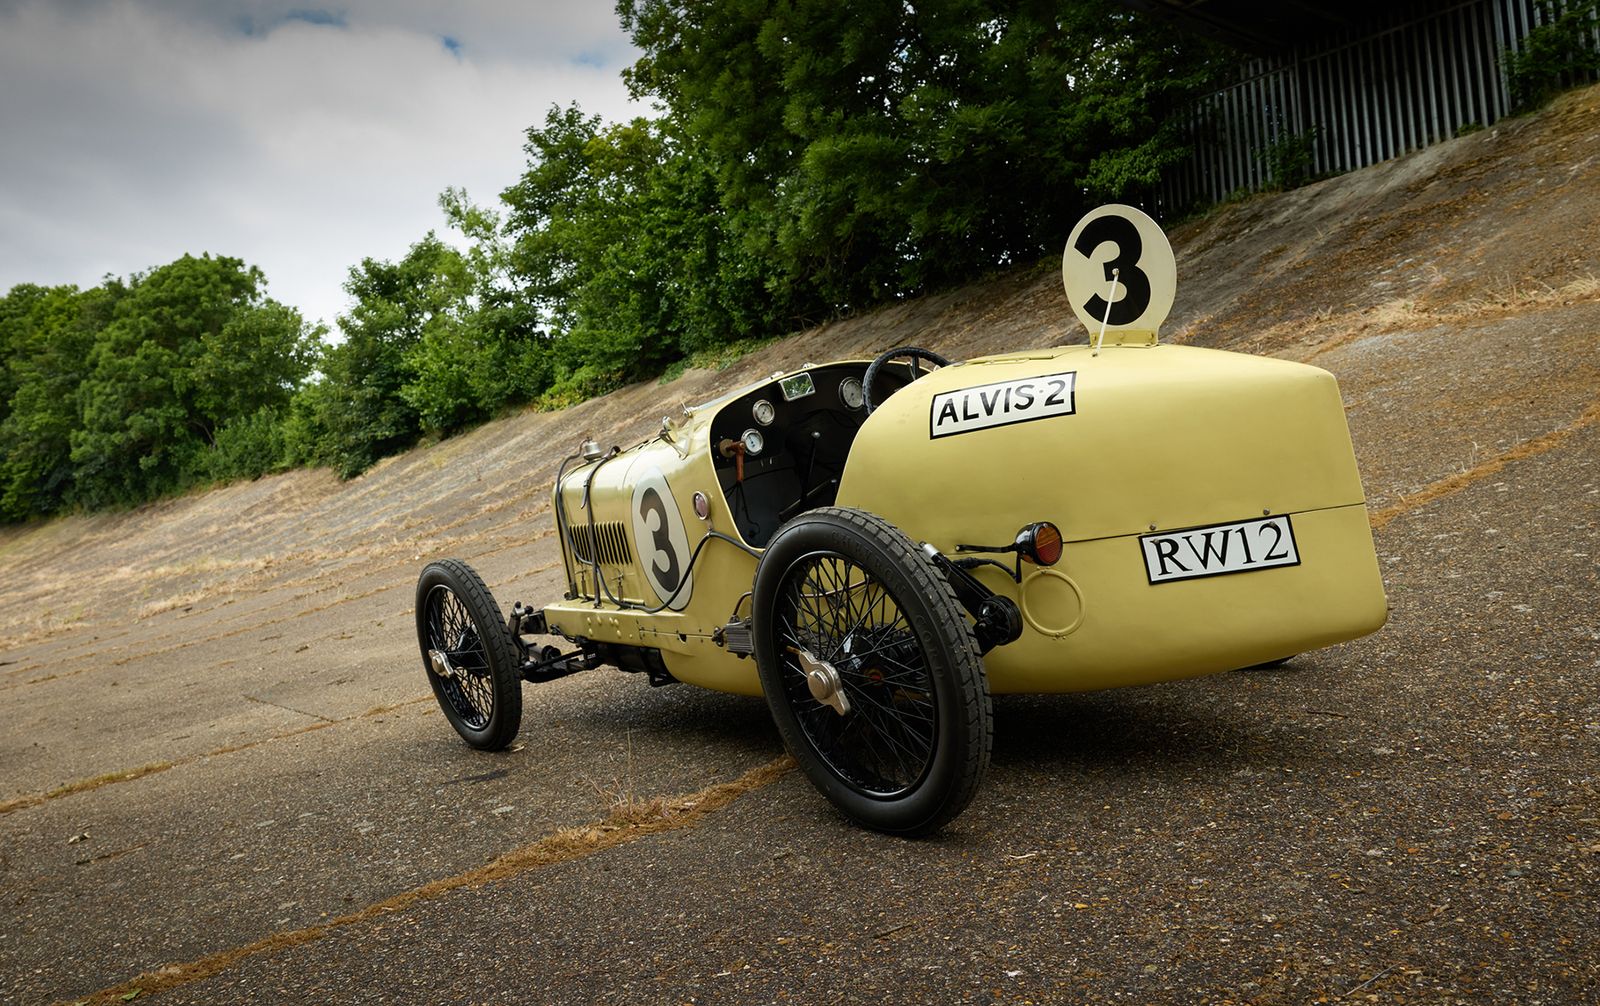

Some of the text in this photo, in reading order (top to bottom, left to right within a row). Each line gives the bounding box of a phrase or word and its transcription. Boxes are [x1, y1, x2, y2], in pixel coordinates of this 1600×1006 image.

[1073, 215, 1151, 325] 3
[639, 487, 681, 593] 3
[1149, 521, 1289, 576] RW12
[914, 614, 944, 678] CORD
